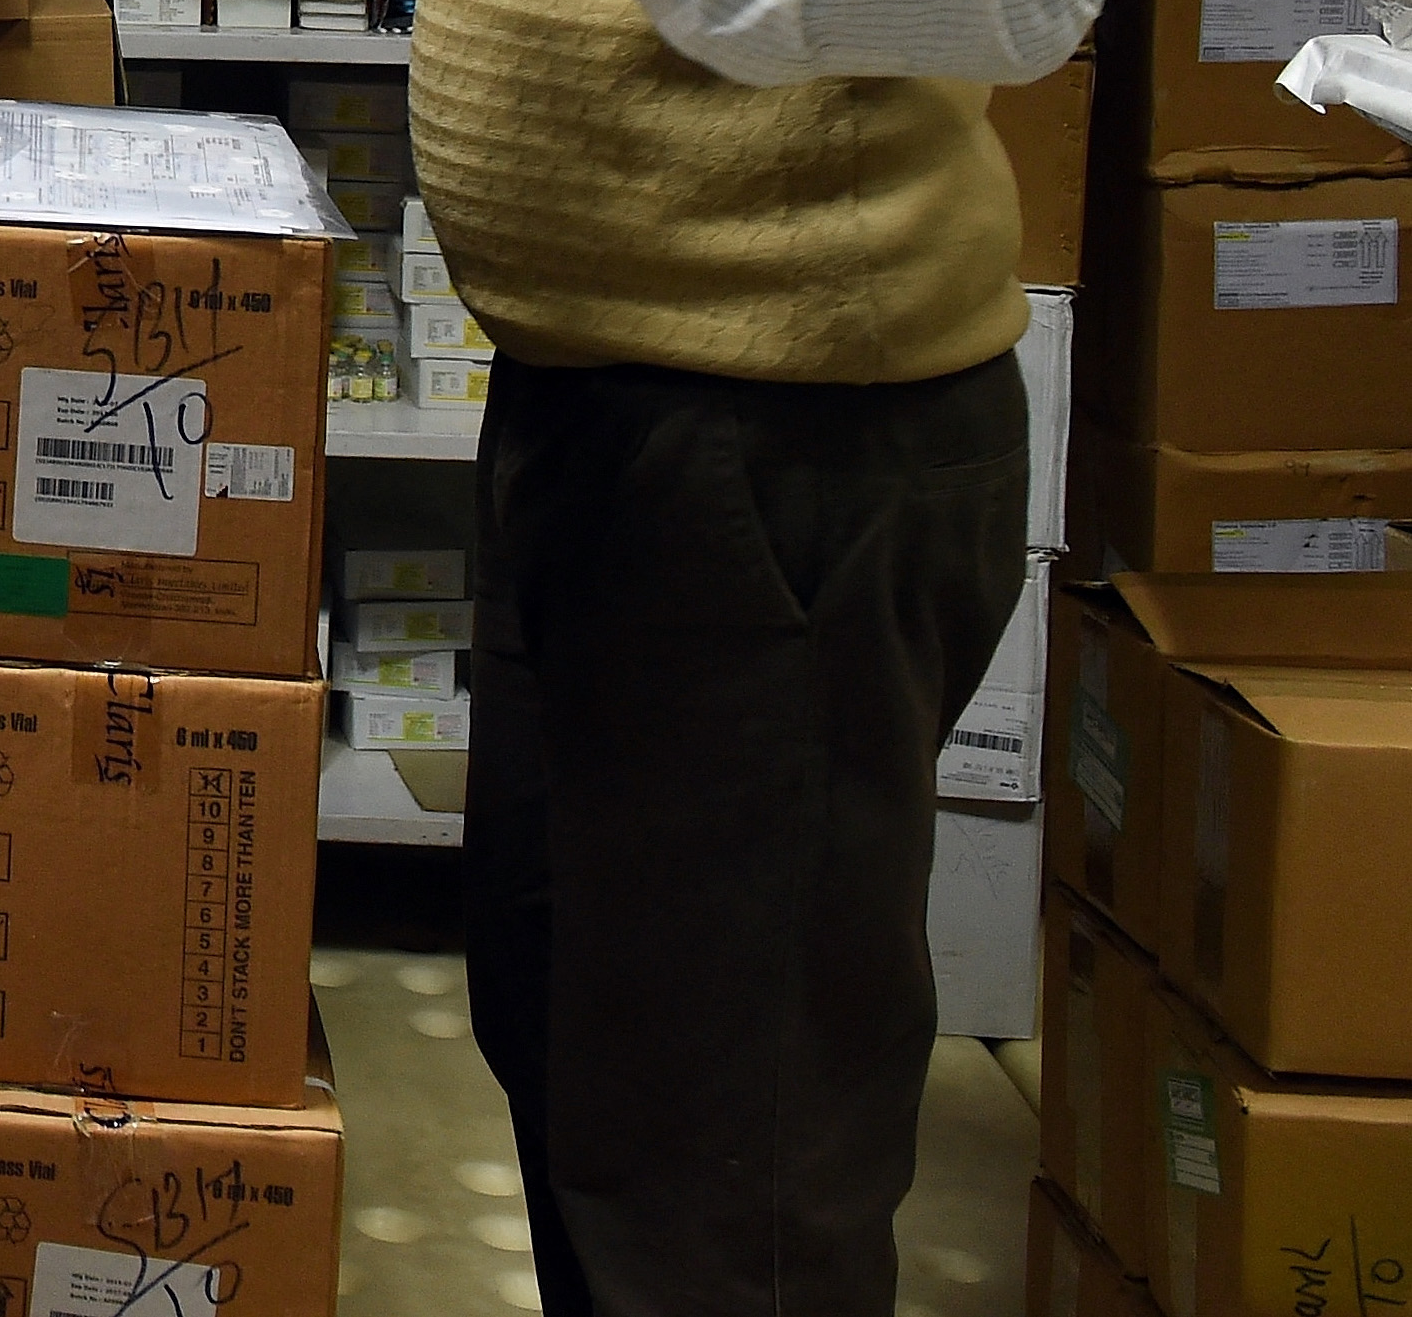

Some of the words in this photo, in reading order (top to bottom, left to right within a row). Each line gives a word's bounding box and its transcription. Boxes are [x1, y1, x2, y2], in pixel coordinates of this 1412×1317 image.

[10, 276, 37, 299] Vial
[10, 711, 38, 734] Vial
[238, 770, 257, 812] TEN
[198, 800, 221, 818] 10
[201, 828, 215, 845] 9
[236, 814, 254, 866] THAN
[201, 855, 214, 871] 8
[234, 872, 253, 931] MORE
[199, 908, 211, 924] 6
[198, 933, 210, 949] 5
[198, 959, 209, 976] 4
[232, 937, 250, 1000] STACK
[197, 985, 209, 1002] 3
[196, 1011, 208, 1028] 2
[230, 1006, 247, 1062] DON'T
[198, 1036, 206, 1053] 1
[28, 1159, 57, 1181] Vial
